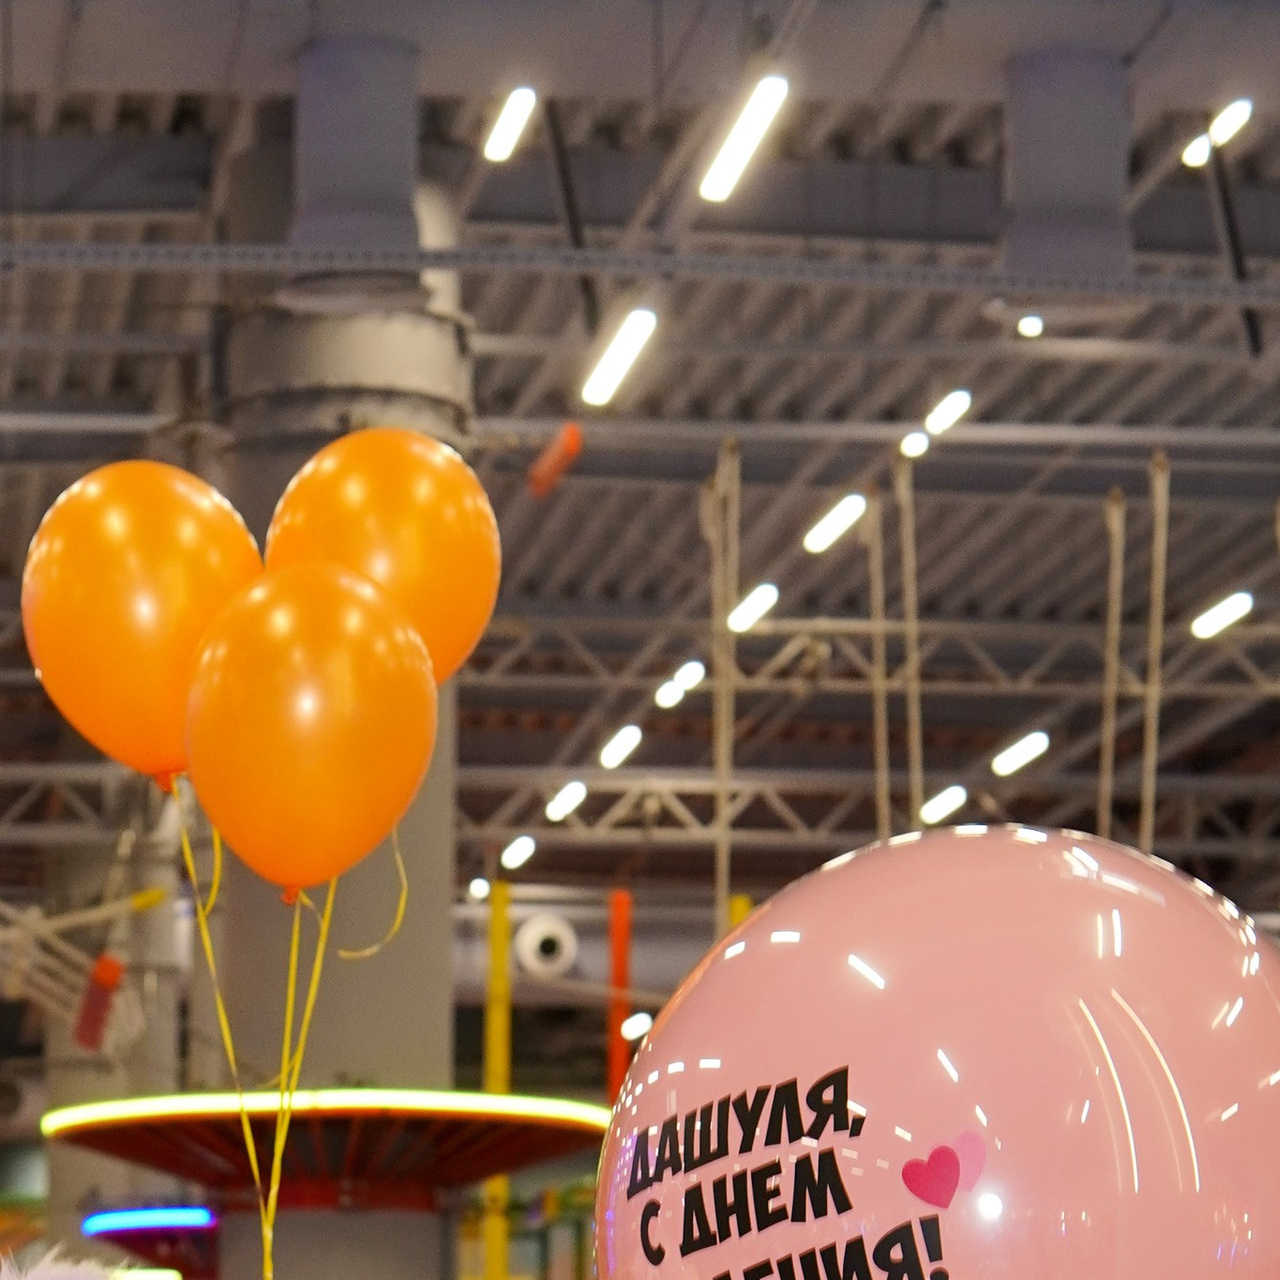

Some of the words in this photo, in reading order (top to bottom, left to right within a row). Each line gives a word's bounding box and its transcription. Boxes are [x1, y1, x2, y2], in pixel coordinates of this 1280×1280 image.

[626, 1064, 867, 1201] ДАШУЛЯ,
[640, 1198, 665, 1266] С
[679, 1146, 854, 1258] ДНЕМ
